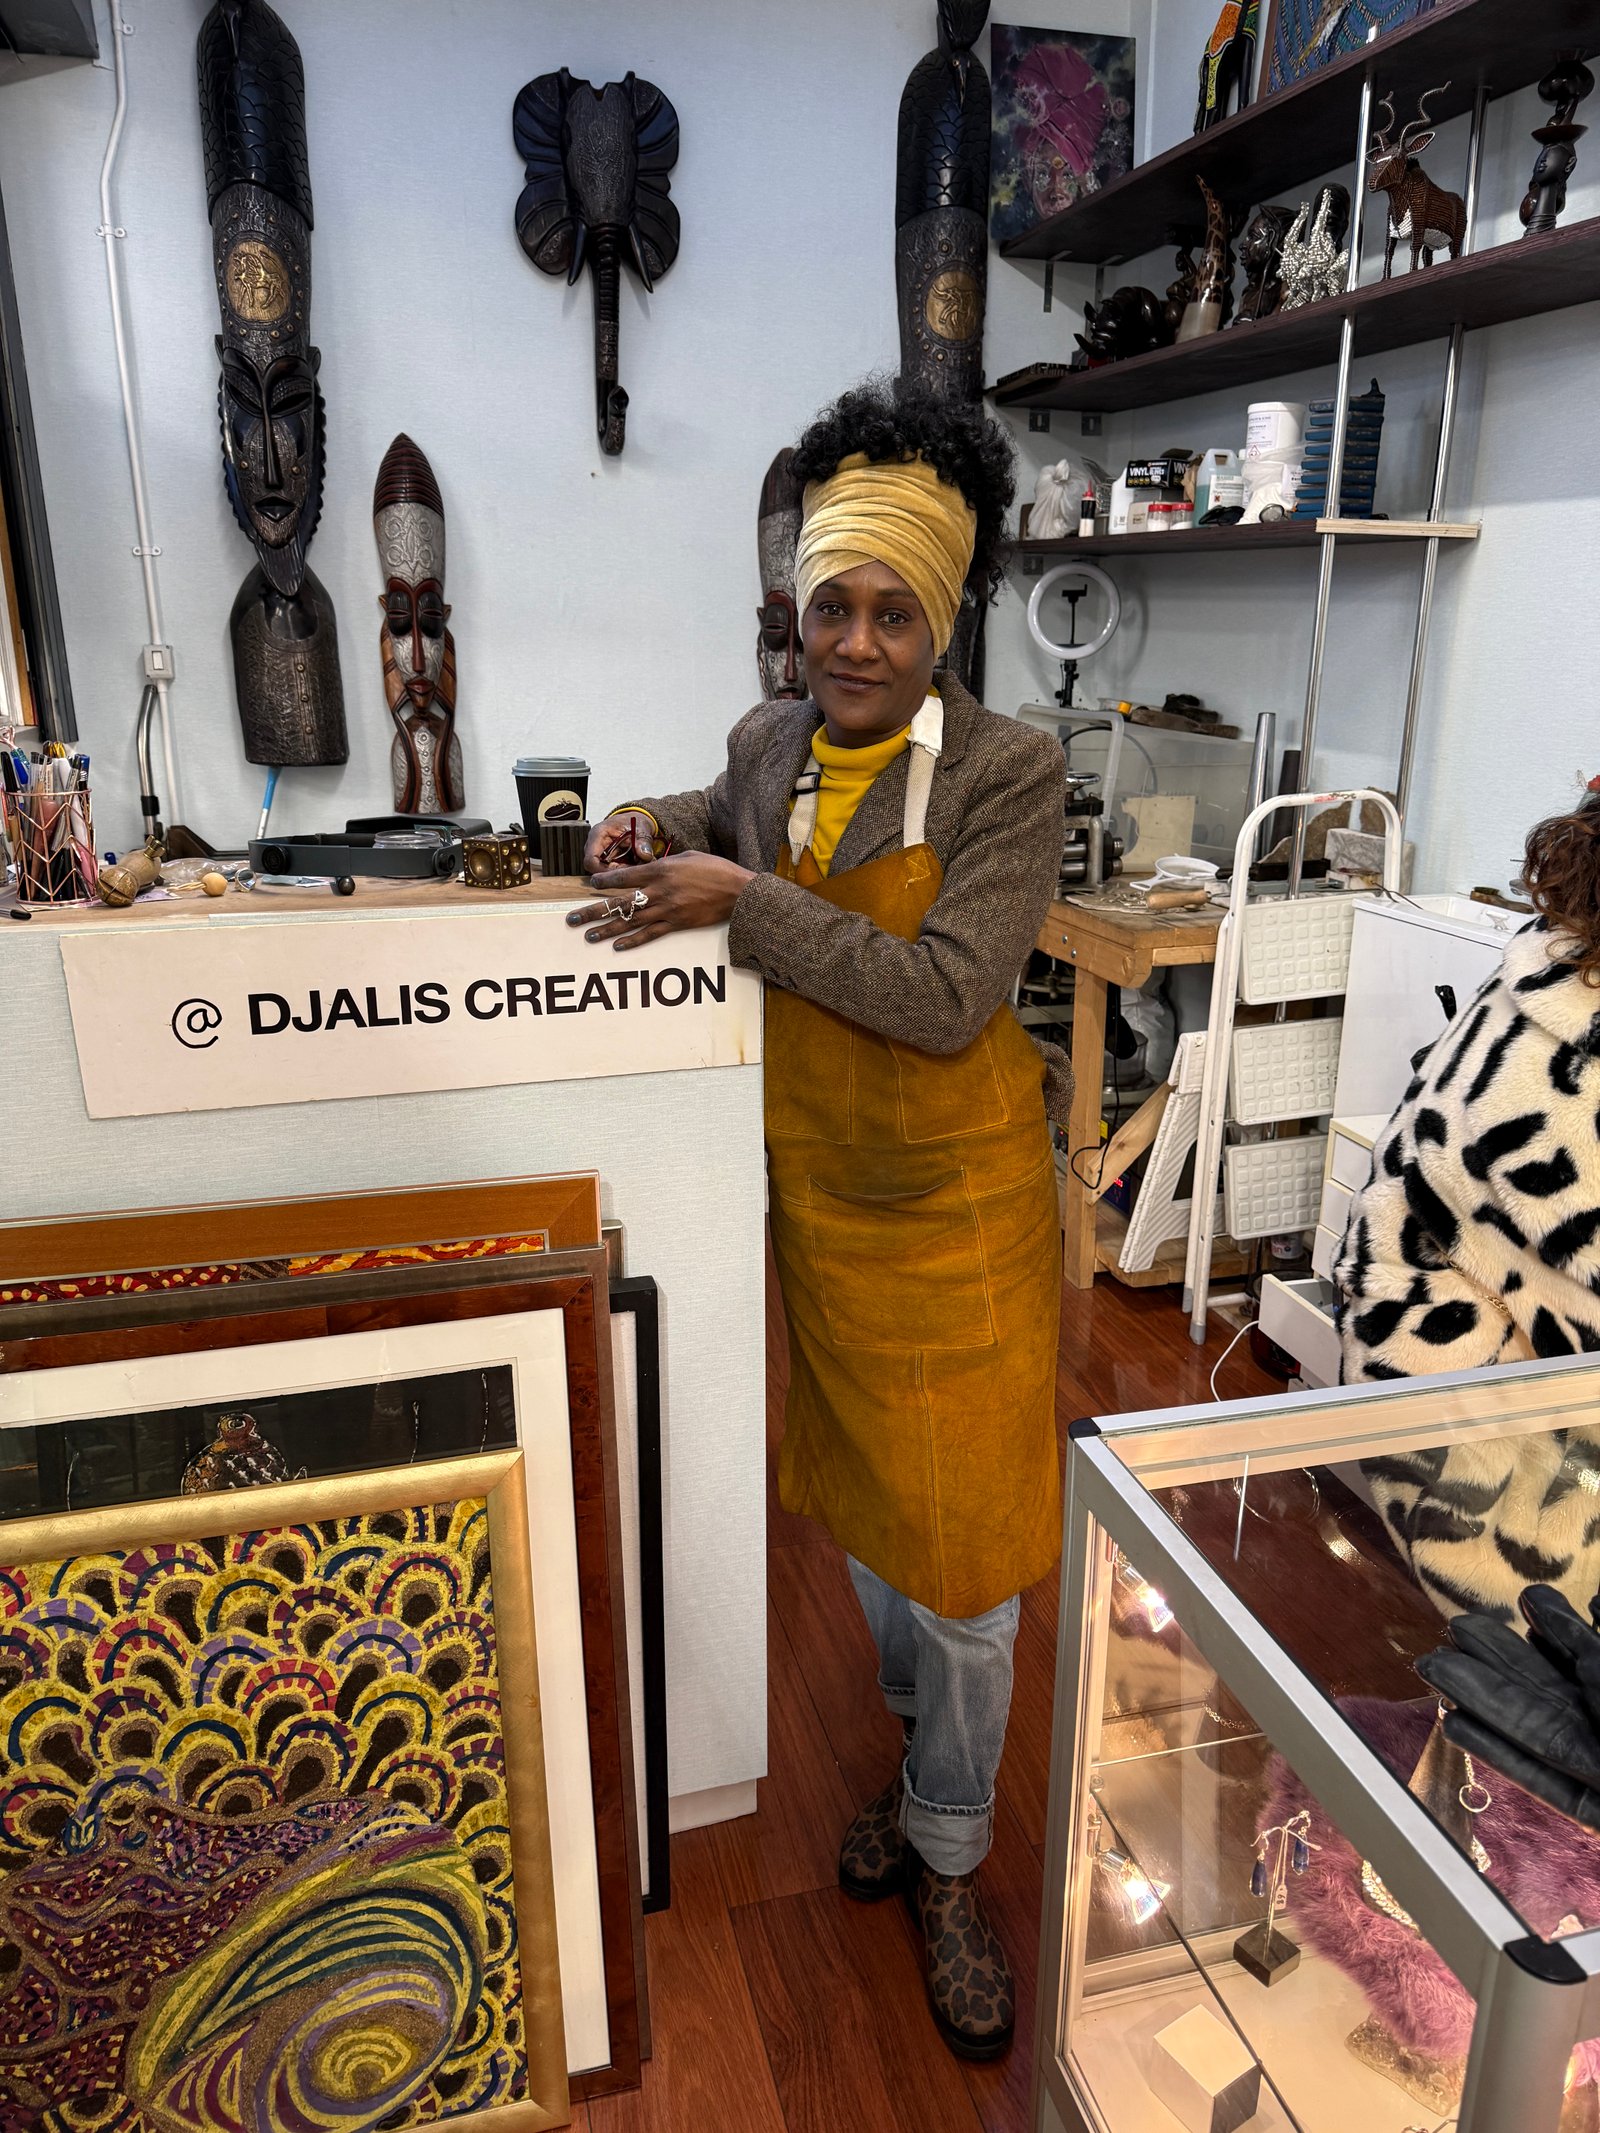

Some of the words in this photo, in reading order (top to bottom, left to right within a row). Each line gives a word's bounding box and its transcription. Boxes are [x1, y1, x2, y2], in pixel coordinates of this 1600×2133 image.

[1129, 467, 1149, 476] VINYL
[1173, 461, 1190, 474] VINY
[172, 998, 222, 1049] @
[248, 982, 450, 1035] DJALIS
[464, 965, 726, 1020] CREATION
